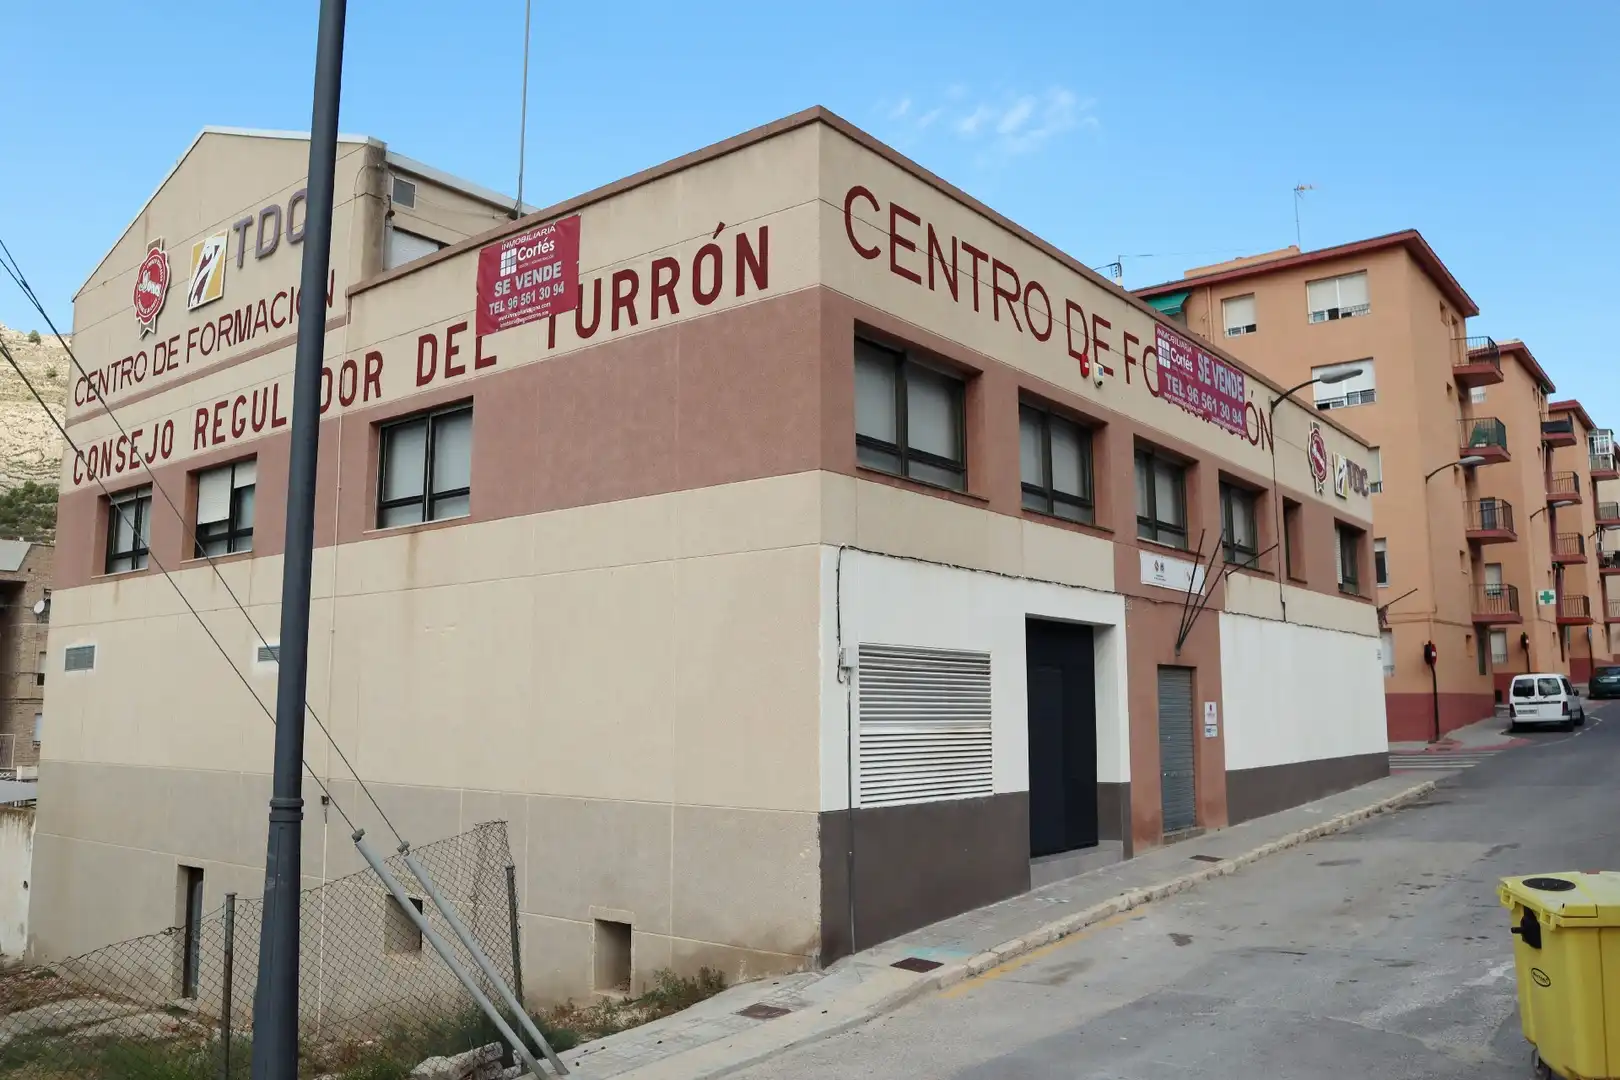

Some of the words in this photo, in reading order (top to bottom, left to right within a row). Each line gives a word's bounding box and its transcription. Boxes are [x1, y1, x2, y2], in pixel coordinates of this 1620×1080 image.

[501, 226, 556, 250] INMOBILIARIA
[517, 237, 555, 261] Cortés
[489, 300, 506, 316] TEL
[507, 296, 518, 310] 96
[520, 290, 536, 306] 561
[539, 286, 551, 300] 30
[553, 281, 565, 296] 94
[494, 278, 511, 297] SE
[515, 261, 562, 290] VENDE
[844, 186, 1053, 342] CENTRO
[1066, 298, 1114, 377] DE
[74, 351, 148, 407] CENTRO
[152, 334, 181, 376] DE
[187, 269, 335, 363] FORMACIN
[1170, 347, 1193, 373] Cortés
[1197, 353, 1211, 385] SE
[1211, 361, 1244, 403] VENDE
[73, 419, 175, 485] CONSEJO
[193, 350, 383, 450] REGULDOR
[416, 321, 497, 387] DEL
[1165, 373, 1186, 398] TEL
[1187, 384, 1199, 405] 96
[1201, 391, 1217, 415] 561
[1219, 402, 1231, 421] 30
[1232, 407, 1243, 426] 94
